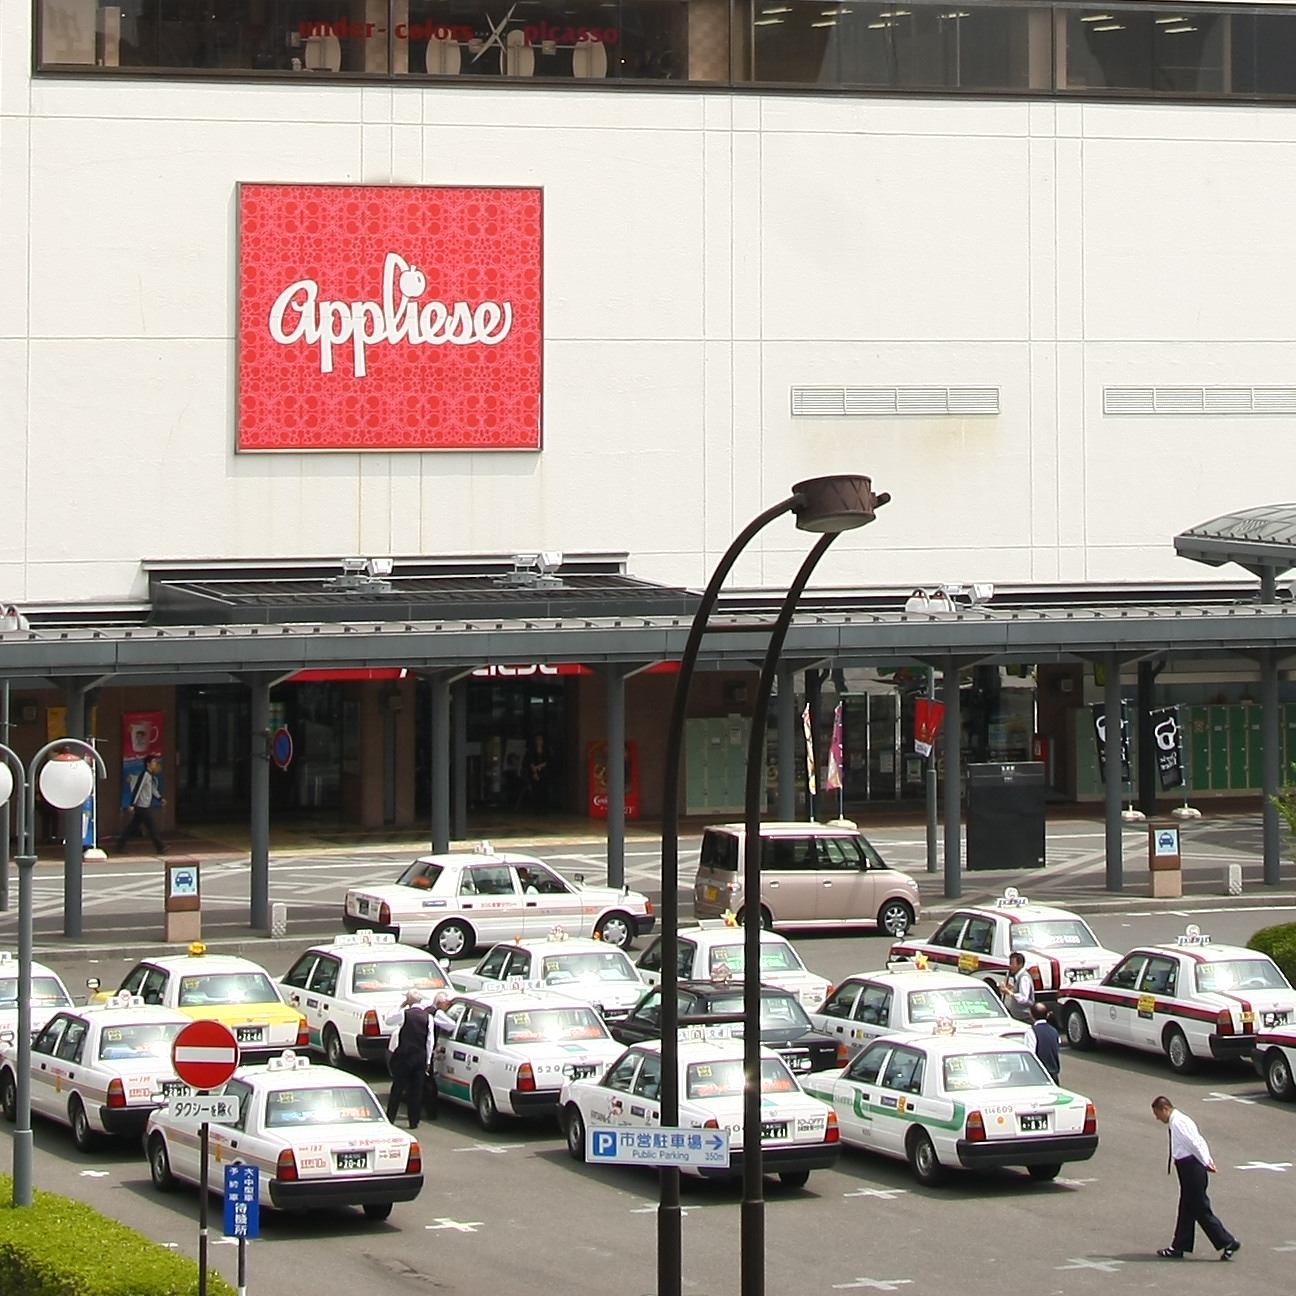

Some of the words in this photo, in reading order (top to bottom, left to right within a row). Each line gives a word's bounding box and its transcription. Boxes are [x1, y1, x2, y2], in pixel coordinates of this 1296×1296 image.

[524, 20, 619, 47] picasso
[268, 252, 513, 378] Appliese
[537, 1064, 561, 1074] 529
[174, 1101, 233, 1118] タクシーを除く
[598, 1134, 613, 1155] P
[619, 1132, 703, 1151] 市営駐車場
[632, 1149, 657, 1159] Public
[659, 1150, 690, 1162] Parking
[705, 1151, 725, 1161] 350m
[234, 1202, 248, 1236] 待機所
